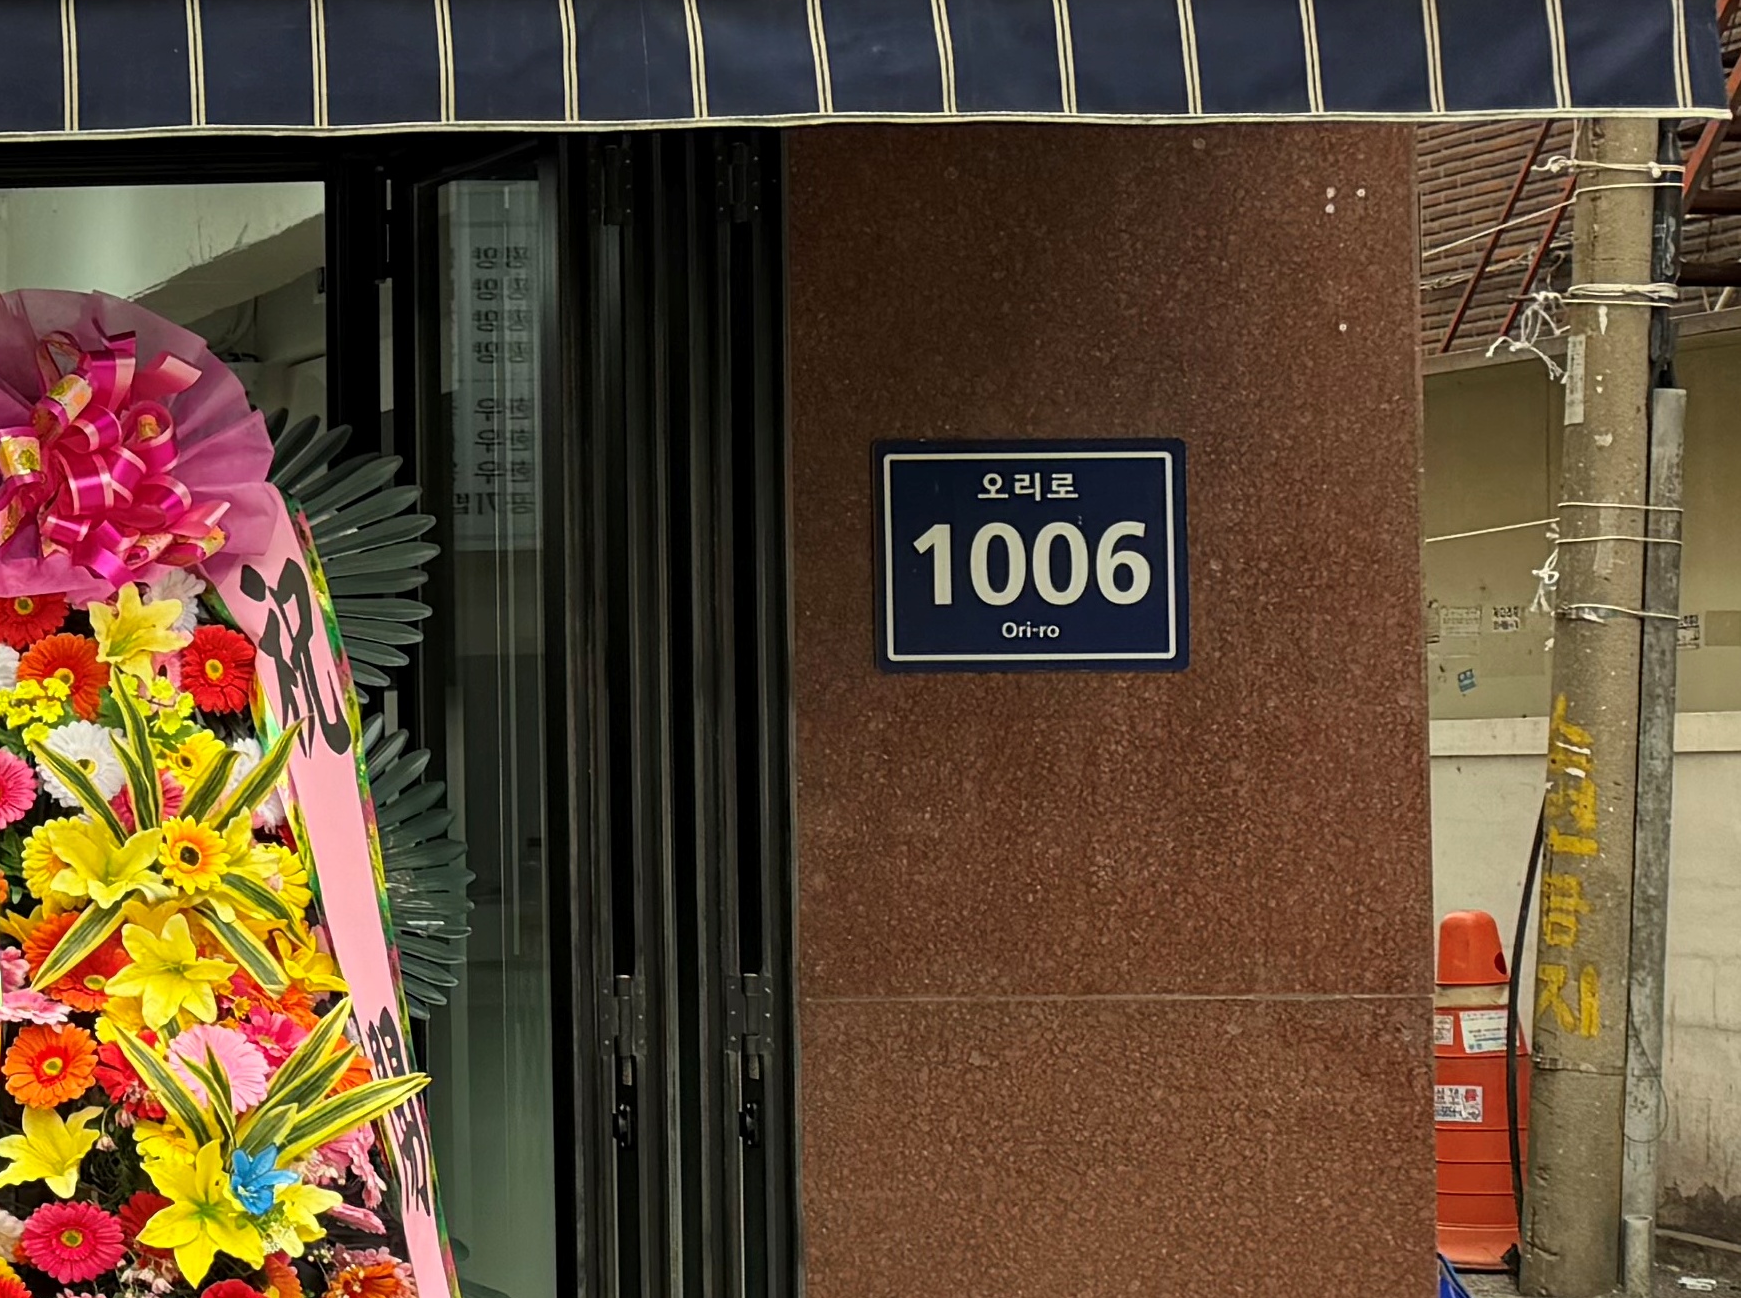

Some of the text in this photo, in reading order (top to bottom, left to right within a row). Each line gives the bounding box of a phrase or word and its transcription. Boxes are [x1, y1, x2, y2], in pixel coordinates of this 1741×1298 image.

[977, 472, 1079, 502] 오리로
[912, 521, 1152, 607] 1006
[1001, 621, 1061, 639] Ori-ro
